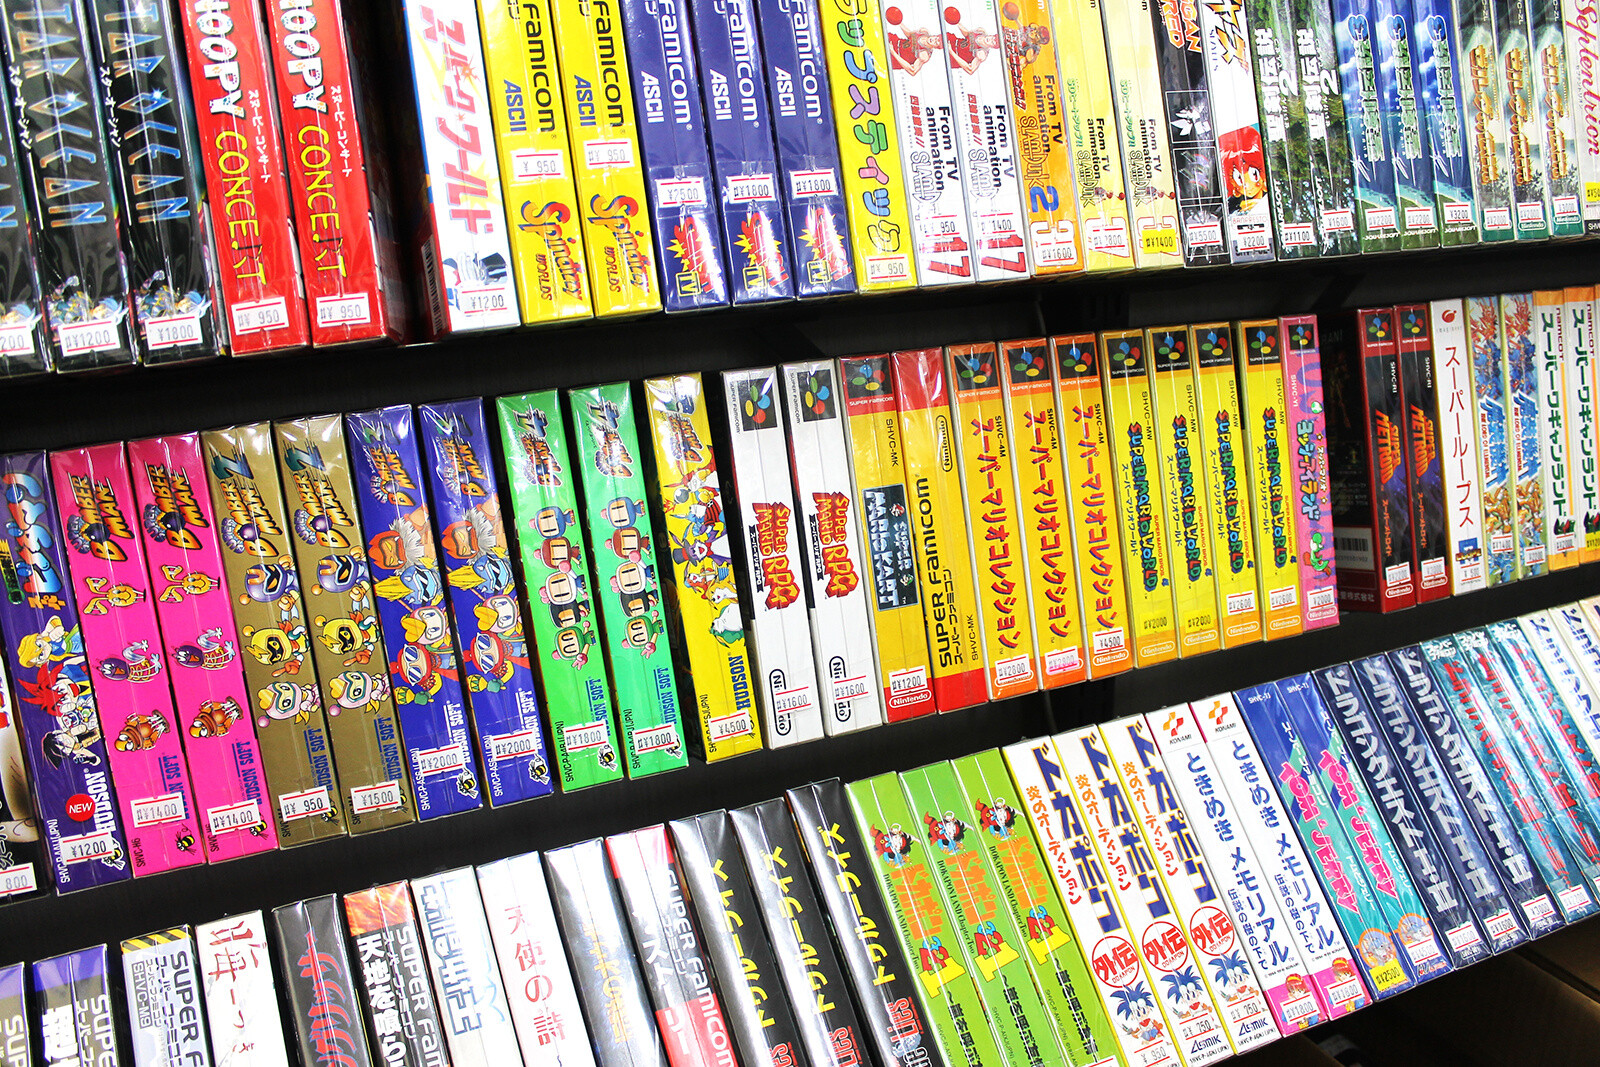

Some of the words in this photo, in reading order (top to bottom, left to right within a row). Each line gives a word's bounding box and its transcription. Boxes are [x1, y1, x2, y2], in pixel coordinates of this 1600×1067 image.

[503, 79, 528, 132] ASCII
[573, 74, 597, 127] ASCII
[641, 70, 665, 123] ASCII
[709, 68, 733, 121] ASCII
[774, 66, 797, 117] ASCII
[1033, 75, 1050, 153] animation
[1044, 74, 1056, 119] From
[1051, 122, 1064, 145] TV
[925, 106, 945, 191] animation
[939, 105, 953, 151] From
[983, 105, 1002, 188] animation
[995, 104, 1008, 149] From
[1002, 154, 1015, 179] TV
[1087, 118, 1101, 179] animation
[1096, 117, 1107, 150] From
[1139, 118, 1153, 179] animation
[1148, 118, 1158, 151] From
[1153, 153, 1163, 173] TV
[945, 156, 959, 181] TV
[1101, 153, 1111, 173] TV
[1141, 391, 1153, 441] SHVC-MW
[1186, 384, 1197, 433] SHVC-MW
[1228, 379, 1239, 428] SHVC-MW
[1275, 377, 1285, 425] SHVC-MW
[1290, 374, 1299, 408] SHVC-YI
[1541, 312, 1567, 517] スーパーワギャンランド
[1572, 308, 1598, 510] スーパーワギャンランド
[885, 418, 899, 467] SHVC-MK
[938, 419, 951, 468] Nintendo
[994, 415, 1006, 458] SHVC-4M
[1046, 408, 1058, 450] SHVC-4M
[1094, 403, 1105, 444] SHVC-4M
[1375, 407, 1394, 485] METROID
[1410, 403, 1429, 479] METROID
[1444, 346, 1474, 528] スーパーループス
[1127, 421, 1147, 478] SUPER
[1139, 531, 1159, 593] WORLD
[1172, 414, 1191, 470] SUPER
[1184, 522, 1202, 582] WORLD
[1215, 409, 1233, 464] SUPER
[1227, 515, 1244, 574] WORLD
[1262, 406, 1279, 460] SUPER
[1272, 510, 1288, 569] WORLD
[754, 503, 773, 557] MARIO
[773, 502, 791, 554] SUPER
[813, 493, 833, 547] MARIO
[833, 492, 850, 543] SUPER
[971, 417, 1021, 649] スーパーマリオコレクション
[1024, 410, 1070, 638] スーパーマリオコレクション
[1072, 405, 1117, 629] スーパーマリオコレクション
[763, 555, 800, 608] RPG
[823, 545, 859, 597] RPG
[936, 588, 953, 668] SUPER
[967, 614, 979, 661] SHVC-MK
[728, 655, 752, 710] HUDSON
[1096, 653, 1128, 664] Nintendo
[893, 693, 928, 705] Nintendo
[719, 719, 747, 734] ¥4500
[1169, 734, 1193, 746] KONAMI
[1213, 721, 1237, 734] KONAMI
[68, 801, 93, 815] NEW
[362, 790, 394, 807] ¥1500
[1122, 761, 1178, 876] 炎のオーディション
[1126, 720, 1217, 904] ドカポン
[1318, 749, 1360, 811] TOM
[1350, 815, 1399, 902] JERRY
[71, 841, 107, 858] ¥1200
[1027, 785, 1081, 905] 炎のオーディション
[1031, 743, 1122, 934] ドカポン
[1075, 773, 1131, 891] 炎のオーディション
[1081, 732, 1171, 920] ドカポン
[1232, 740, 1280, 829] ときめき
[1276, 833, 1334, 950] メモリアル
[1280, 760, 1321, 825] TOM
[1309, 829, 1361, 916] JERRY
[1187, 752, 1236, 843] ときめき
[1230, 846, 1289, 967] メモリアル
[817, 822, 897, 986] トゥルーライズ
[1190, 911, 1234, 951] 外伝
[396, 925, 429, 1013] SUPER
[1094, 941, 1139, 981] 外伝
[1143, 927, 1187, 966] 外伝
[169, 950, 200, 1044] SUPER
